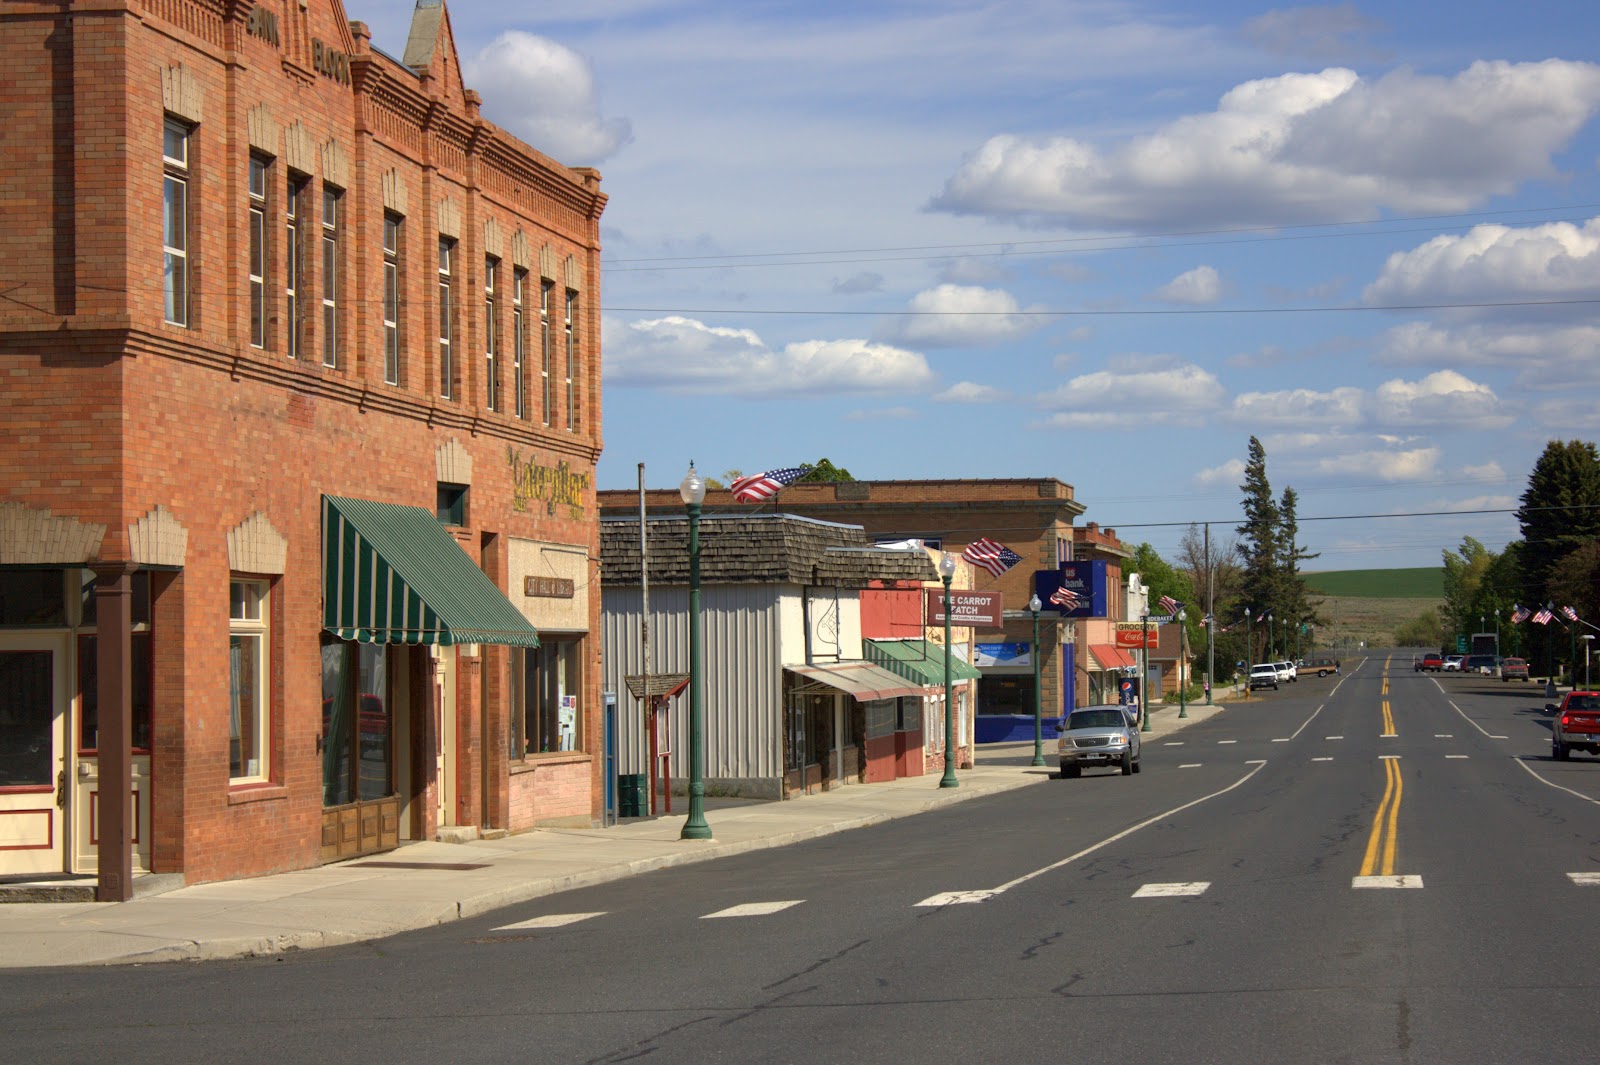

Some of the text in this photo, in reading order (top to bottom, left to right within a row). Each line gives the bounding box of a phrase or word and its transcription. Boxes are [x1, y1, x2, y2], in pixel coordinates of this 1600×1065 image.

[248, 4, 279, 47] BANK
[312, 38, 349, 85] BLOCK
[1065, 578, 1084, 588] bank
[938, 595, 991, 606] TE CARROT
[951, 605, 978, 615] PATCH
[1125, 632, 1150, 640] Coca-Co
